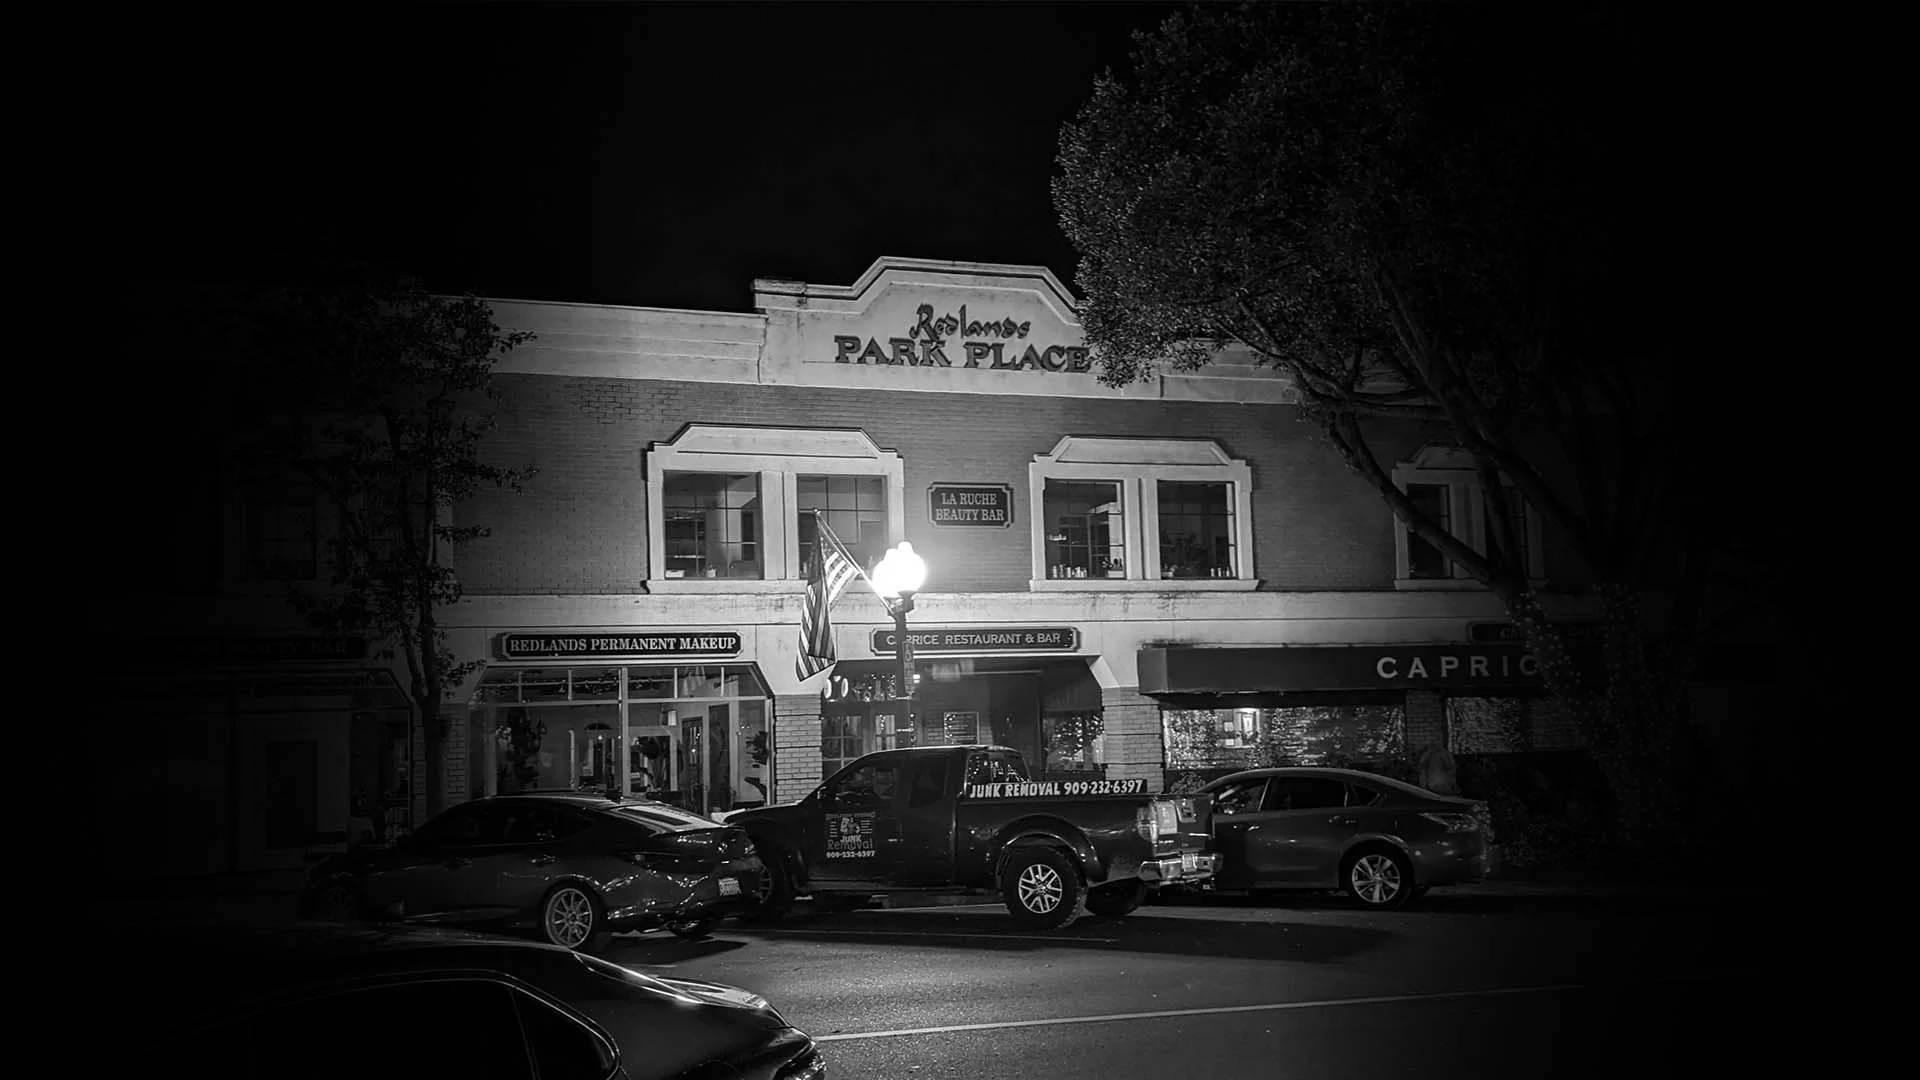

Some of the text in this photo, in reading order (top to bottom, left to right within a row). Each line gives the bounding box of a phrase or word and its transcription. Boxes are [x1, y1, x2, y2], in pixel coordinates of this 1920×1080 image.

[909, 304, 1031, 340] Redlands
[834, 335, 1091, 373] PARK PLACE
[941, 492, 997, 505] LA RUCHE
[936, 508, 1005, 521] BEAUTY BAR
[510, 637, 737, 652] REDLANDS PERMANENT MAKEUP
[886, 633, 1061, 645] CPRICE RESTAURANT & BAR
[969, 784, 1001, 798] JUNK
[1004, 782, 1061, 797] REMOVAL
